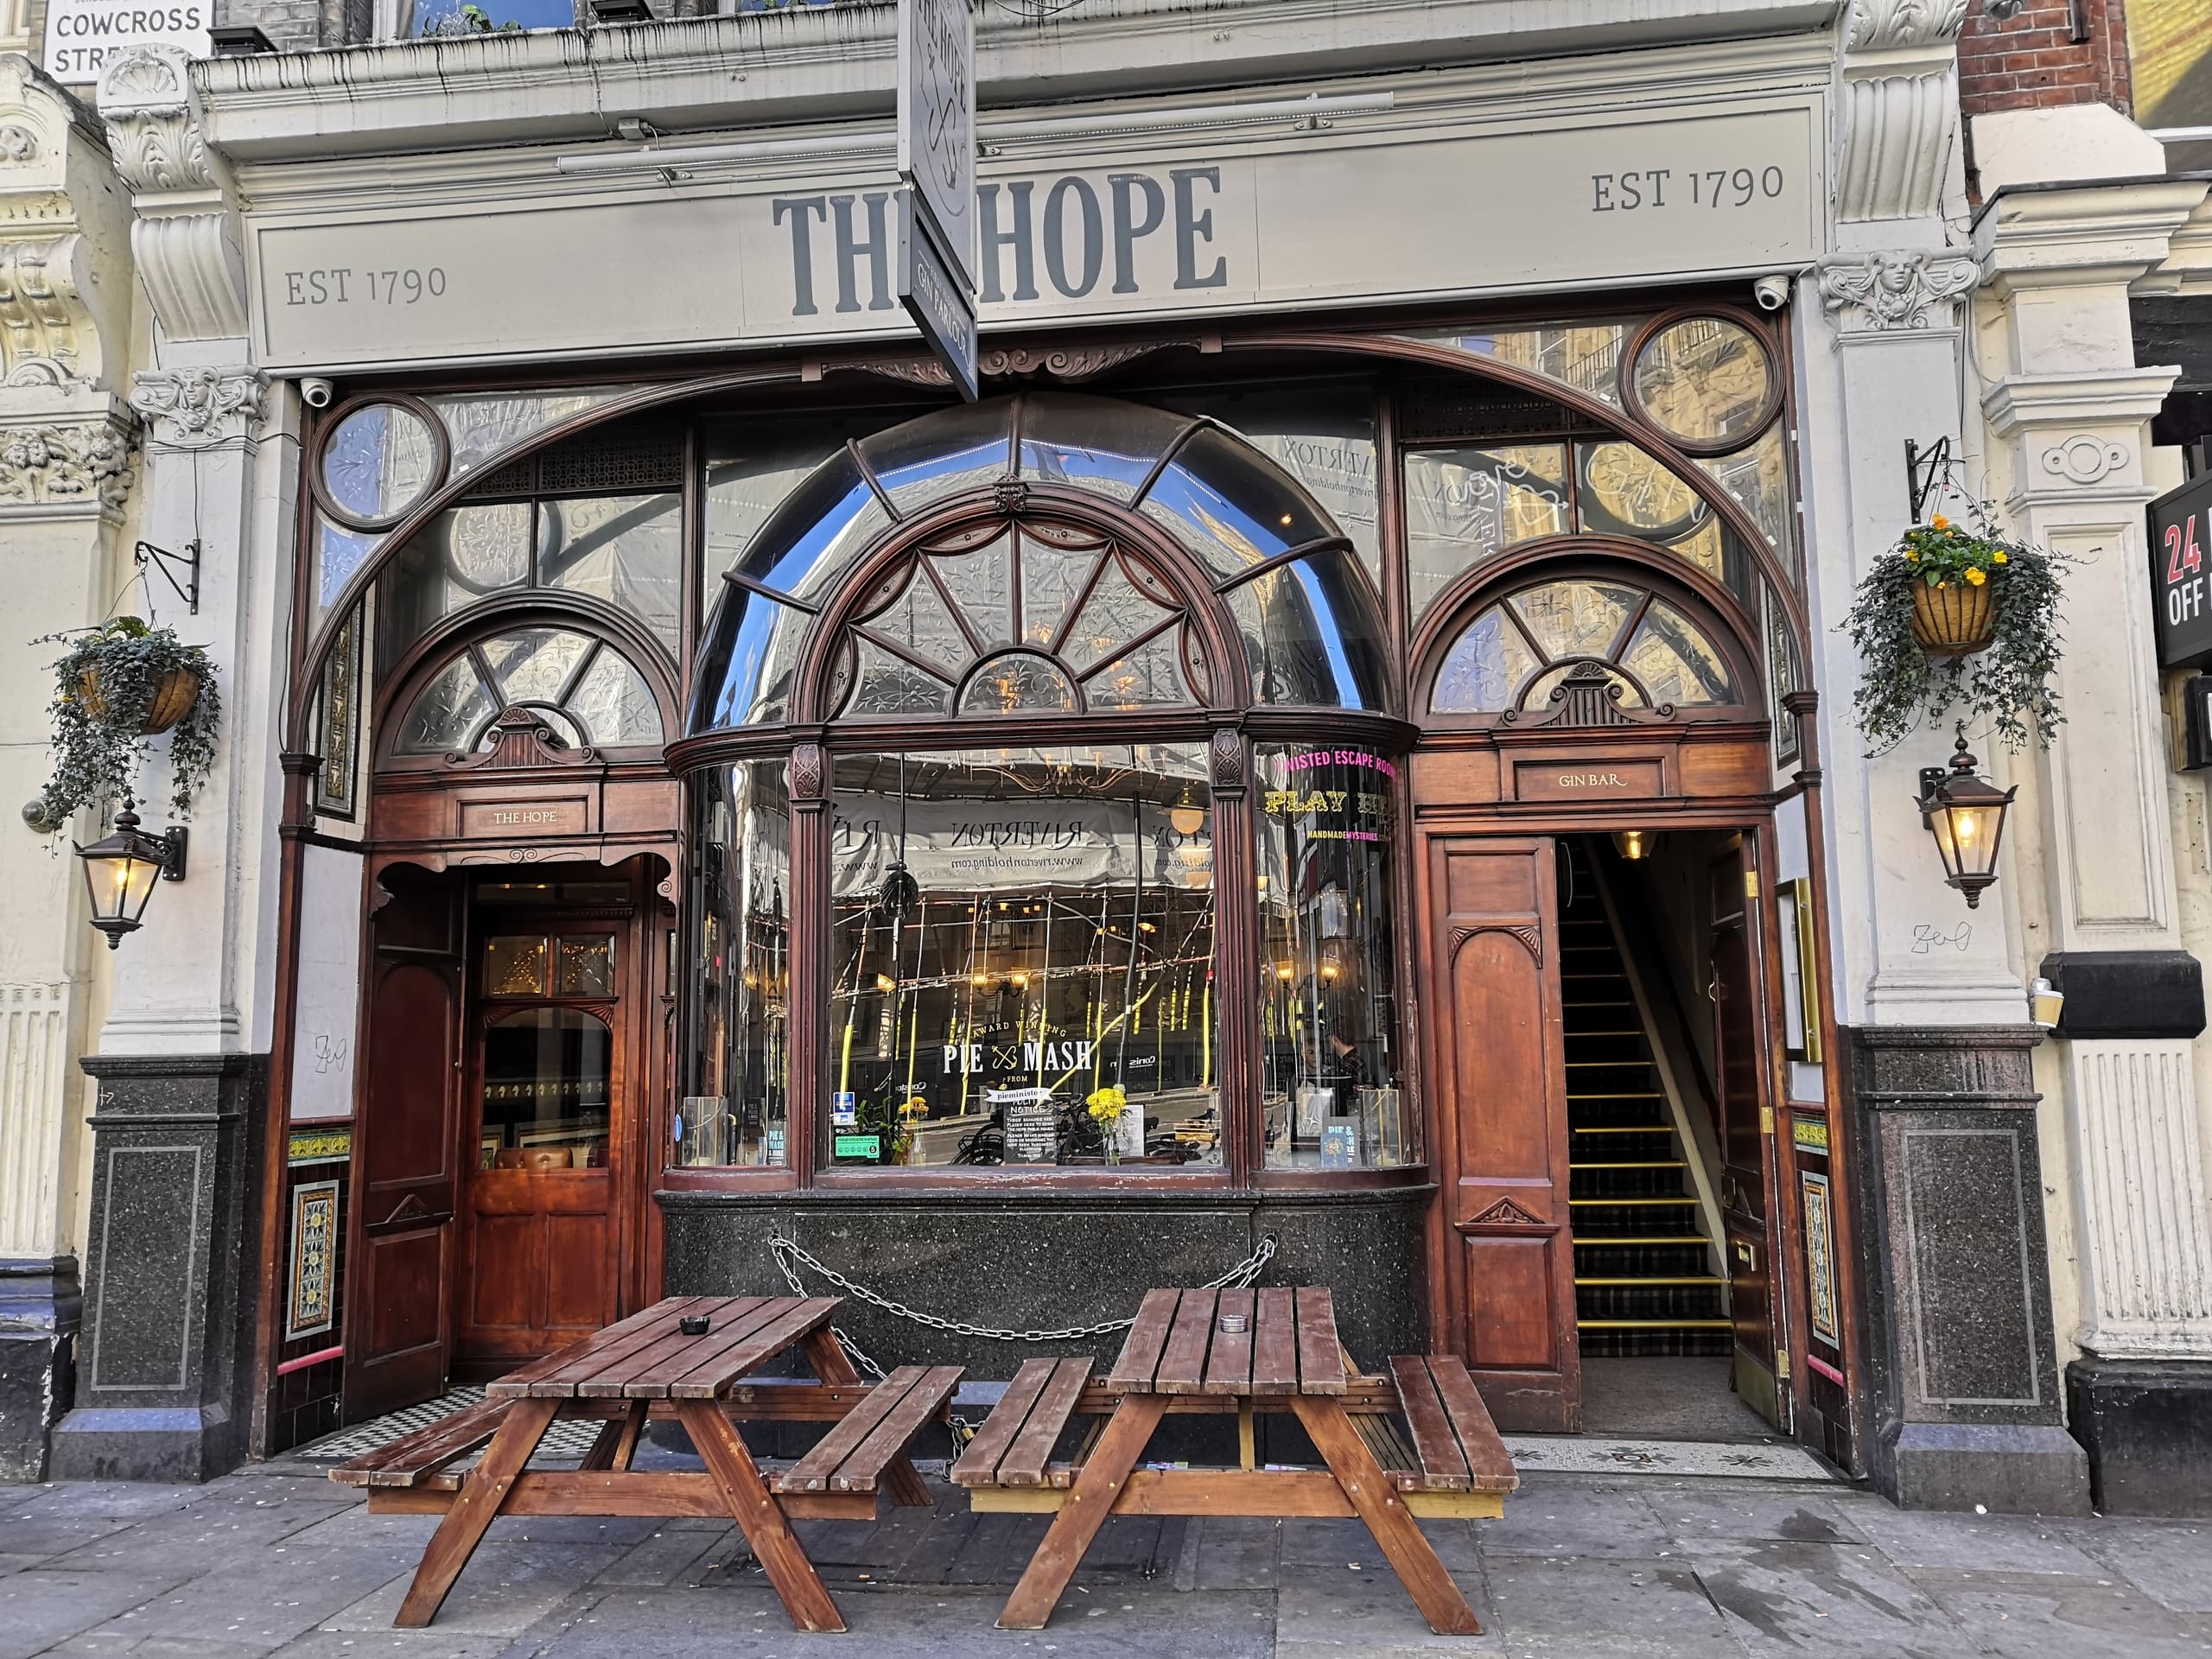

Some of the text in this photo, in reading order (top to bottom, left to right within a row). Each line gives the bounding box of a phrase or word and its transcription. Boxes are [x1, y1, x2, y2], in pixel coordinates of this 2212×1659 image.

[56, 7, 200, 37] COWCROSS
[54, 47, 123, 73] STR
[939, 10, 966, 114] HOPE
[1592, 165, 1784, 213] EST 1790
[772, 166, 1228, 316] TH HOPE
[285, 267, 448, 306] EST 1790
[918, 263, 969, 361] GIN PARLOUR
[2164, 514, 2202, 585] 24
[2169, 577, 2203, 626] OFF
[1335, 751, 1373, 768] ESCAPE
[1559, 773, 1628, 787] GIN BAR
[493, 810, 556, 824] THE HOPE
[1265, 791, 1348, 813] PLAY
[973, 1020, 1067, 1038] AWARD WINING
[943, 1040, 1092, 1073] PIE MASH
